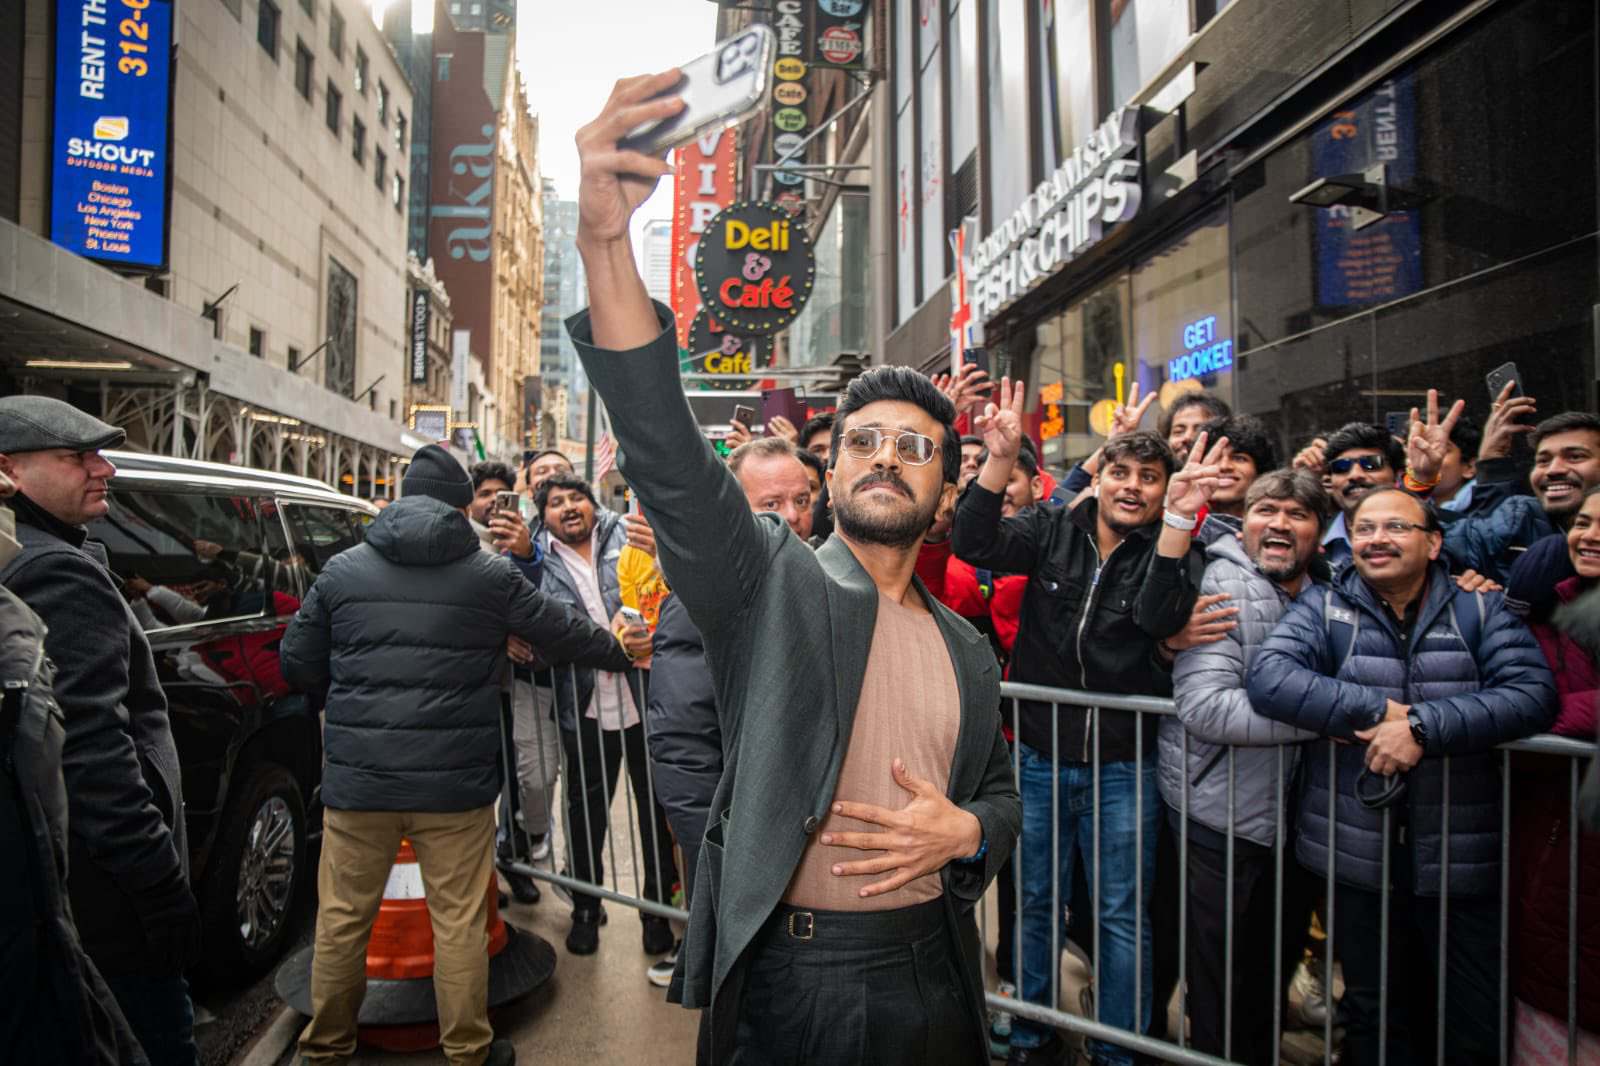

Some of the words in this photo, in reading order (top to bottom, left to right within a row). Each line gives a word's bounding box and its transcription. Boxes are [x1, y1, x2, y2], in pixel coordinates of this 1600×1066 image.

[776, 1, 803, 55] CAFE
[80, 30, 105, 100] RENT
[67, 138, 155, 167] SHOUT
[67, 156, 117, 172] OUTDOOR
[121, 166, 154, 178] MEDIA
[88, 191, 132, 208] Chicago
[92, 181, 129, 195] Boston
[430, 123, 497, 263] aka.
[77, 202, 97, 214] Los
[99, 206, 142, 220] Angeles
[84, 215, 109, 227] New
[111, 218, 134, 230] York
[86, 238, 100, 250] St.
[102, 241, 131, 254] Louis
[88, 227, 130, 241] Phoenix
[725, 220, 790, 251] Deli
[973, 246, 1018, 322] FISH
[1020, 238, 1042, 288] &
[1039, 160, 1141, 272] CHIPS
[742, 253, 772, 281] &
[719, 275, 795, 309] Café
[721, 334, 742, 355] &
[1184, 316, 1216, 349] GET
[413, 341, 425, 379] HOUSE
